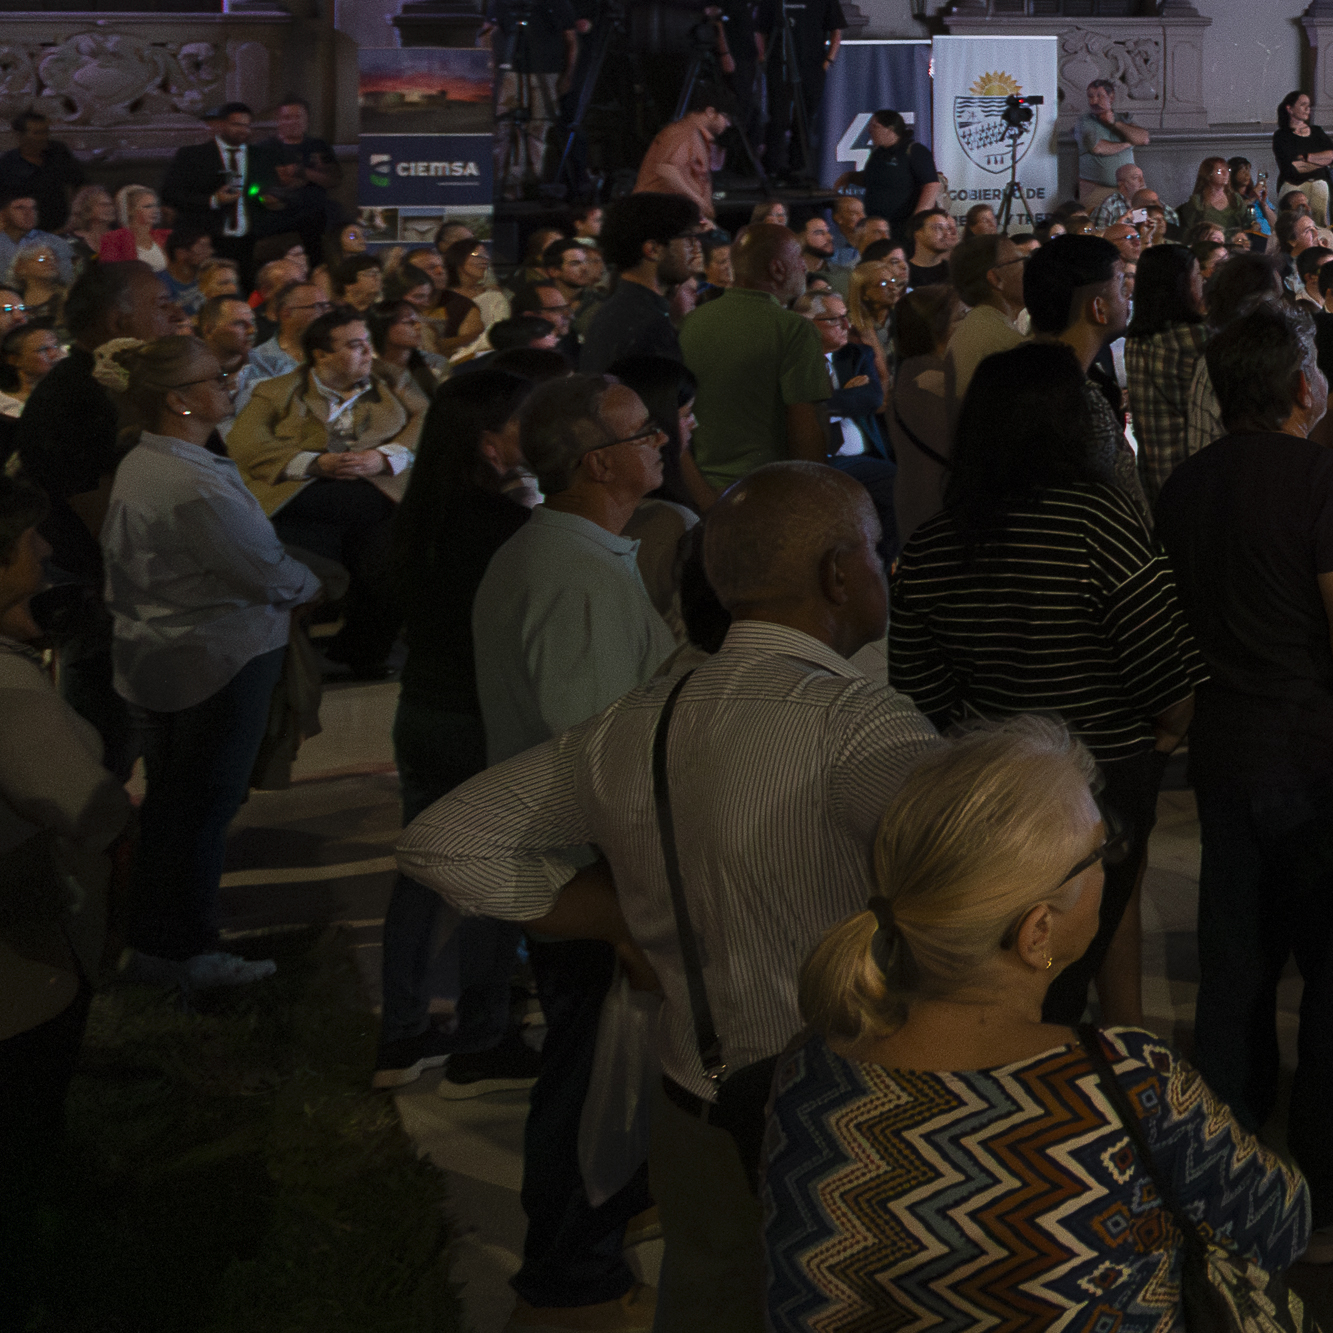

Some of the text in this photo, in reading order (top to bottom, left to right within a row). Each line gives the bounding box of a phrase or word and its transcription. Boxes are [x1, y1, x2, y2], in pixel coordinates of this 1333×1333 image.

[396, 161, 480, 177] CIEMSA
[949, 188, 1046, 201] GOBIERO DE
